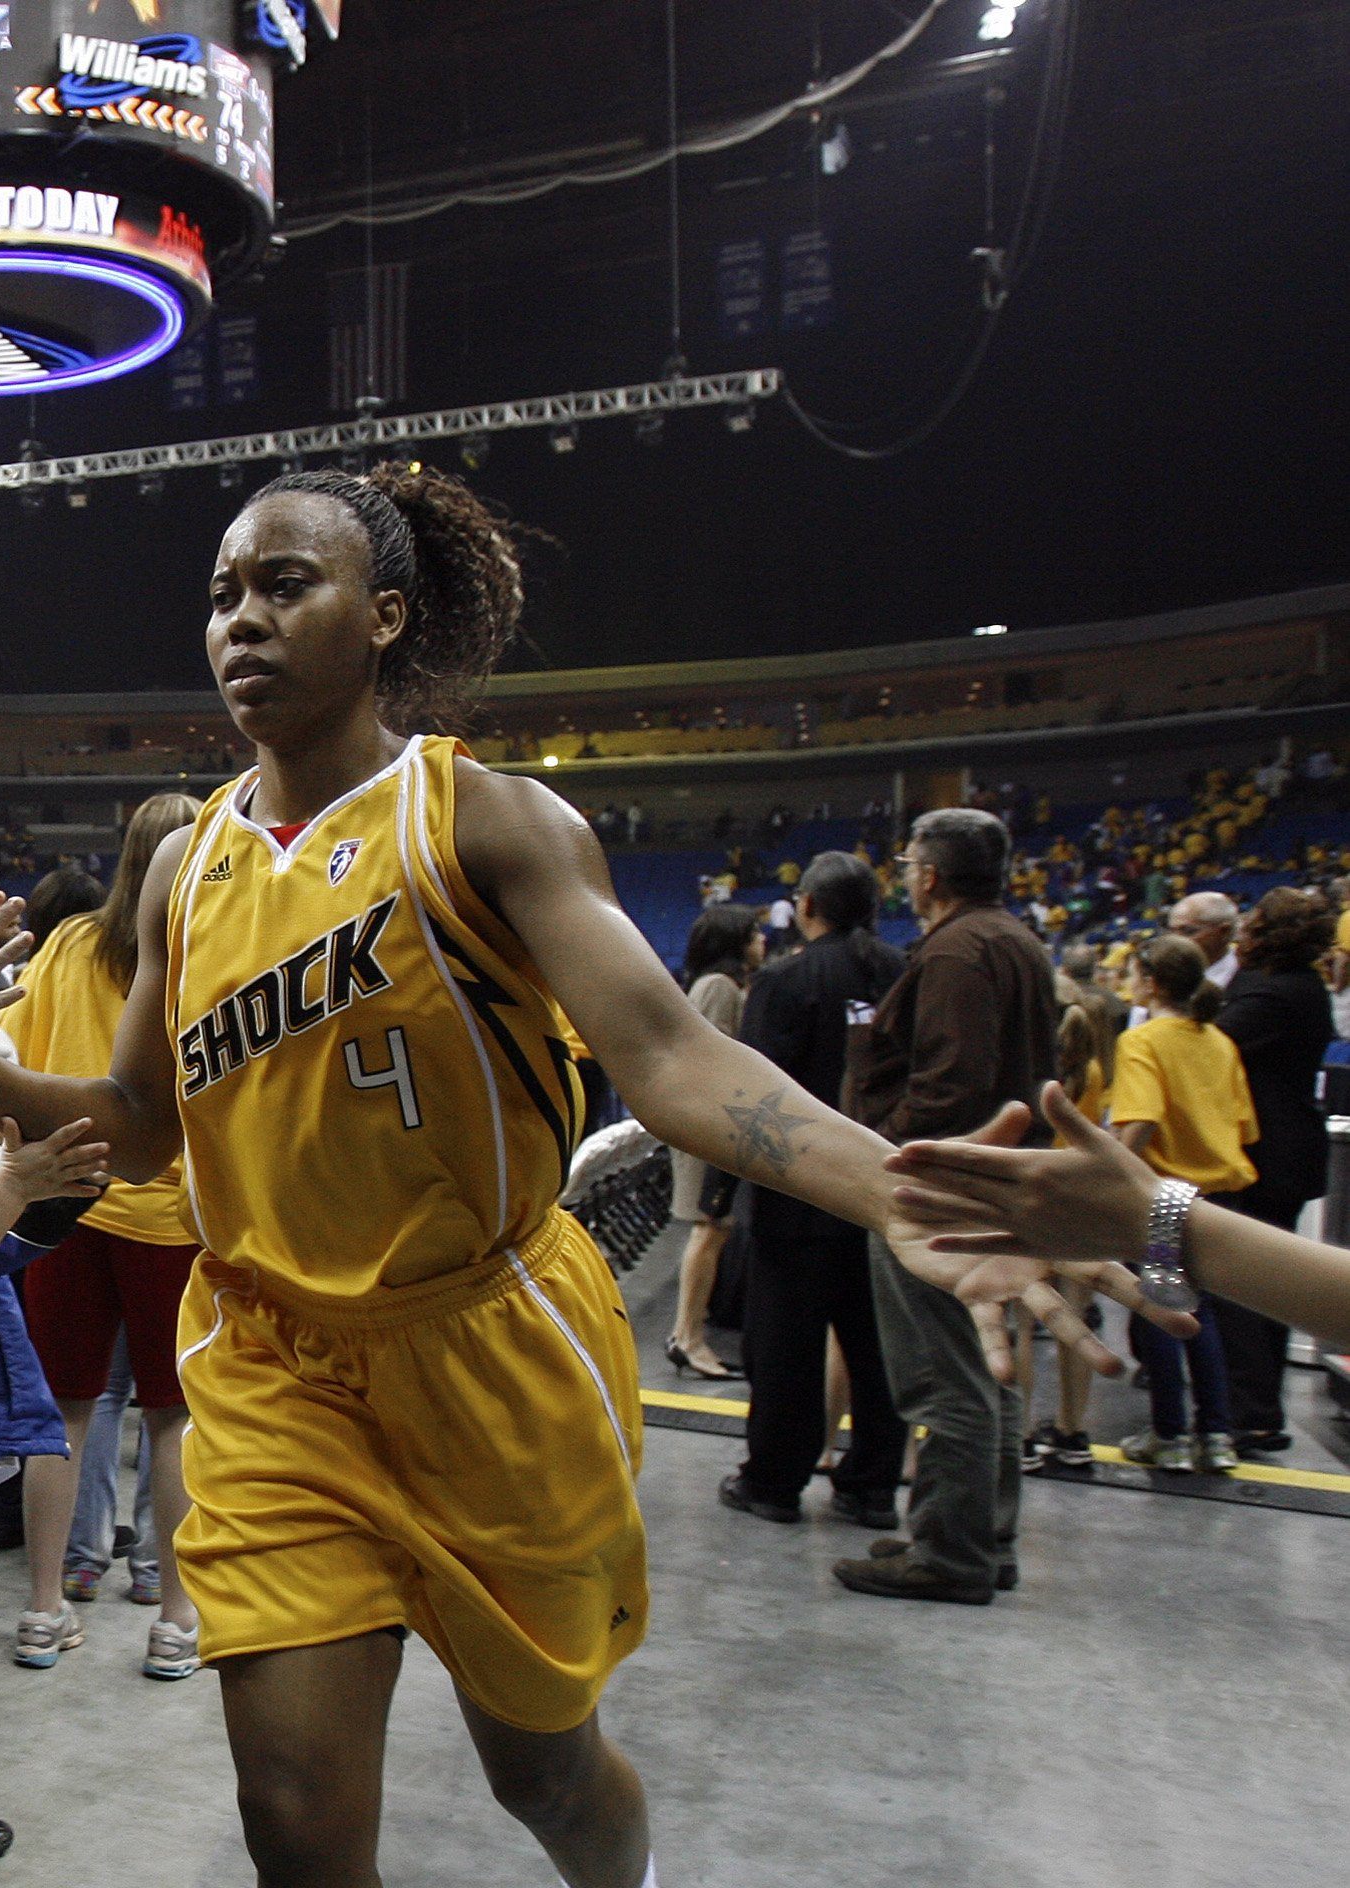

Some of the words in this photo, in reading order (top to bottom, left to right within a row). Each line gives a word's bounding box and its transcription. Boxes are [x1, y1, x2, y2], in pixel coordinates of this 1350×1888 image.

[59, 33, 208, 97] Williams
[216, 90, 244, 137] 74
[177, 889, 401, 1101] SHOCK
[343, 1025, 422, 1131] 4
